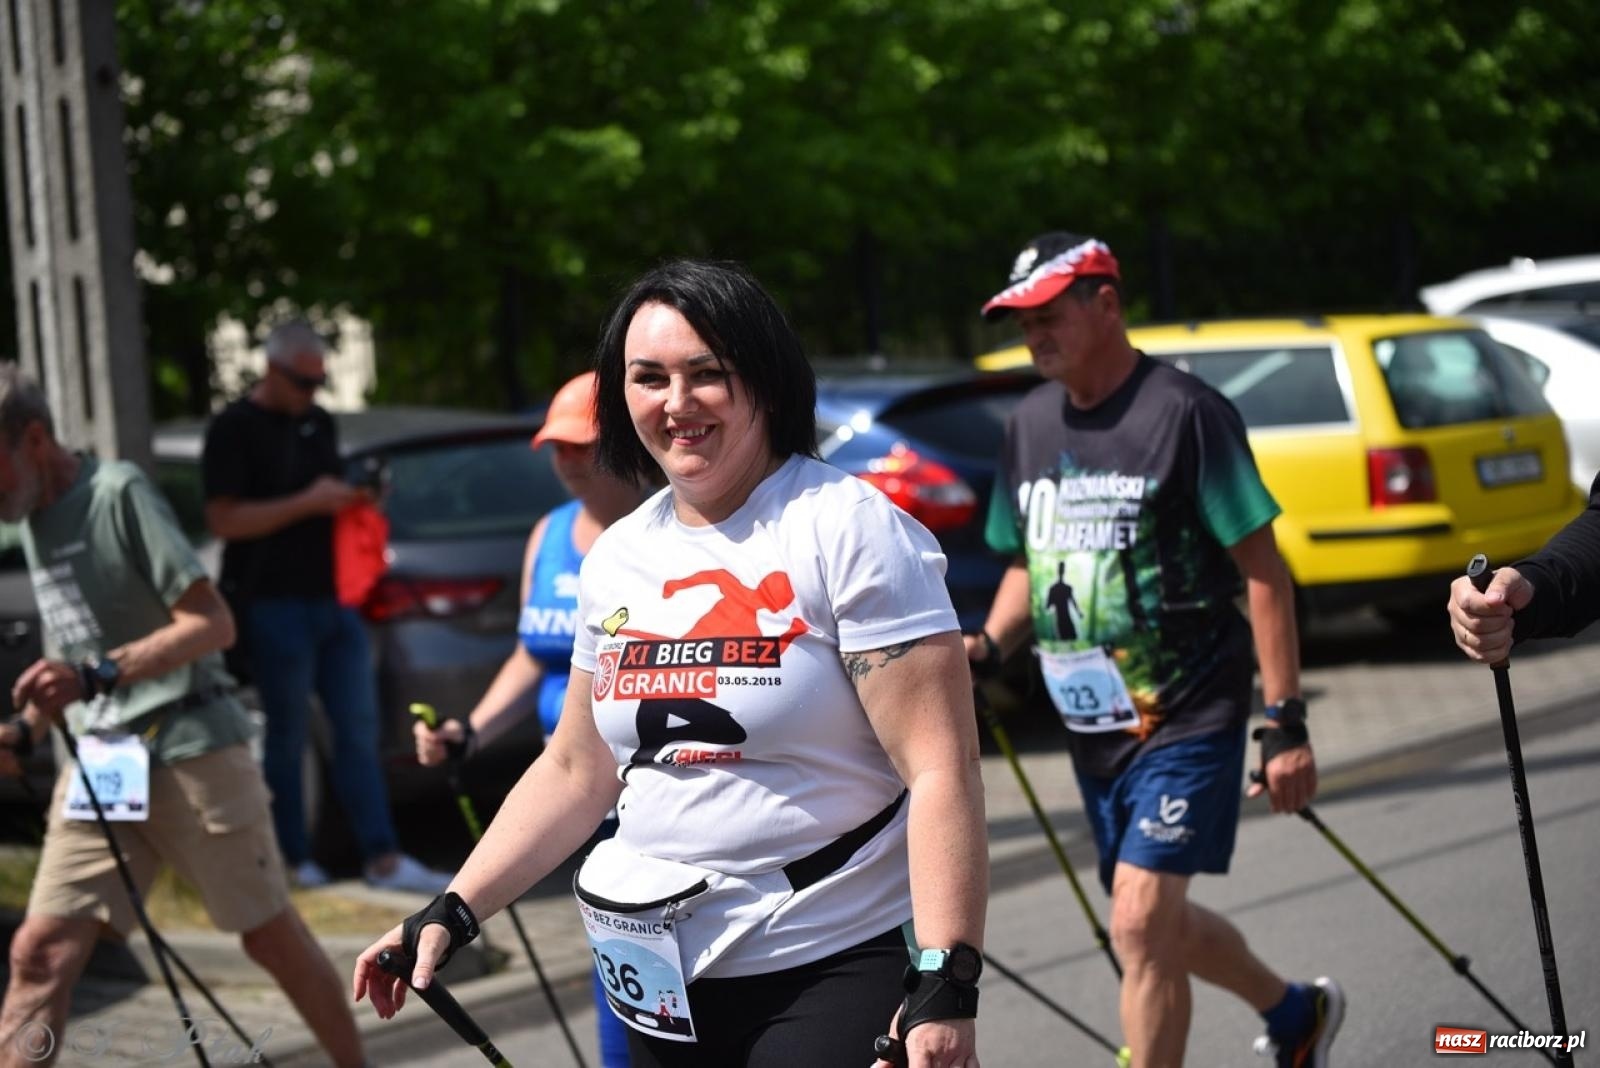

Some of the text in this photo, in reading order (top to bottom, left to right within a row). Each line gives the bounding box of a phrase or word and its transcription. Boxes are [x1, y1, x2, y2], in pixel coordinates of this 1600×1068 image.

[623, 640, 776, 666] XI BIEG BEZ
[618, 670, 714, 695] GRANIC
[717, 676, 782, 687] 03.05.2018
[593, 911, 612, 928] BEZ
[613, 918, 663, 935] GRANIC
